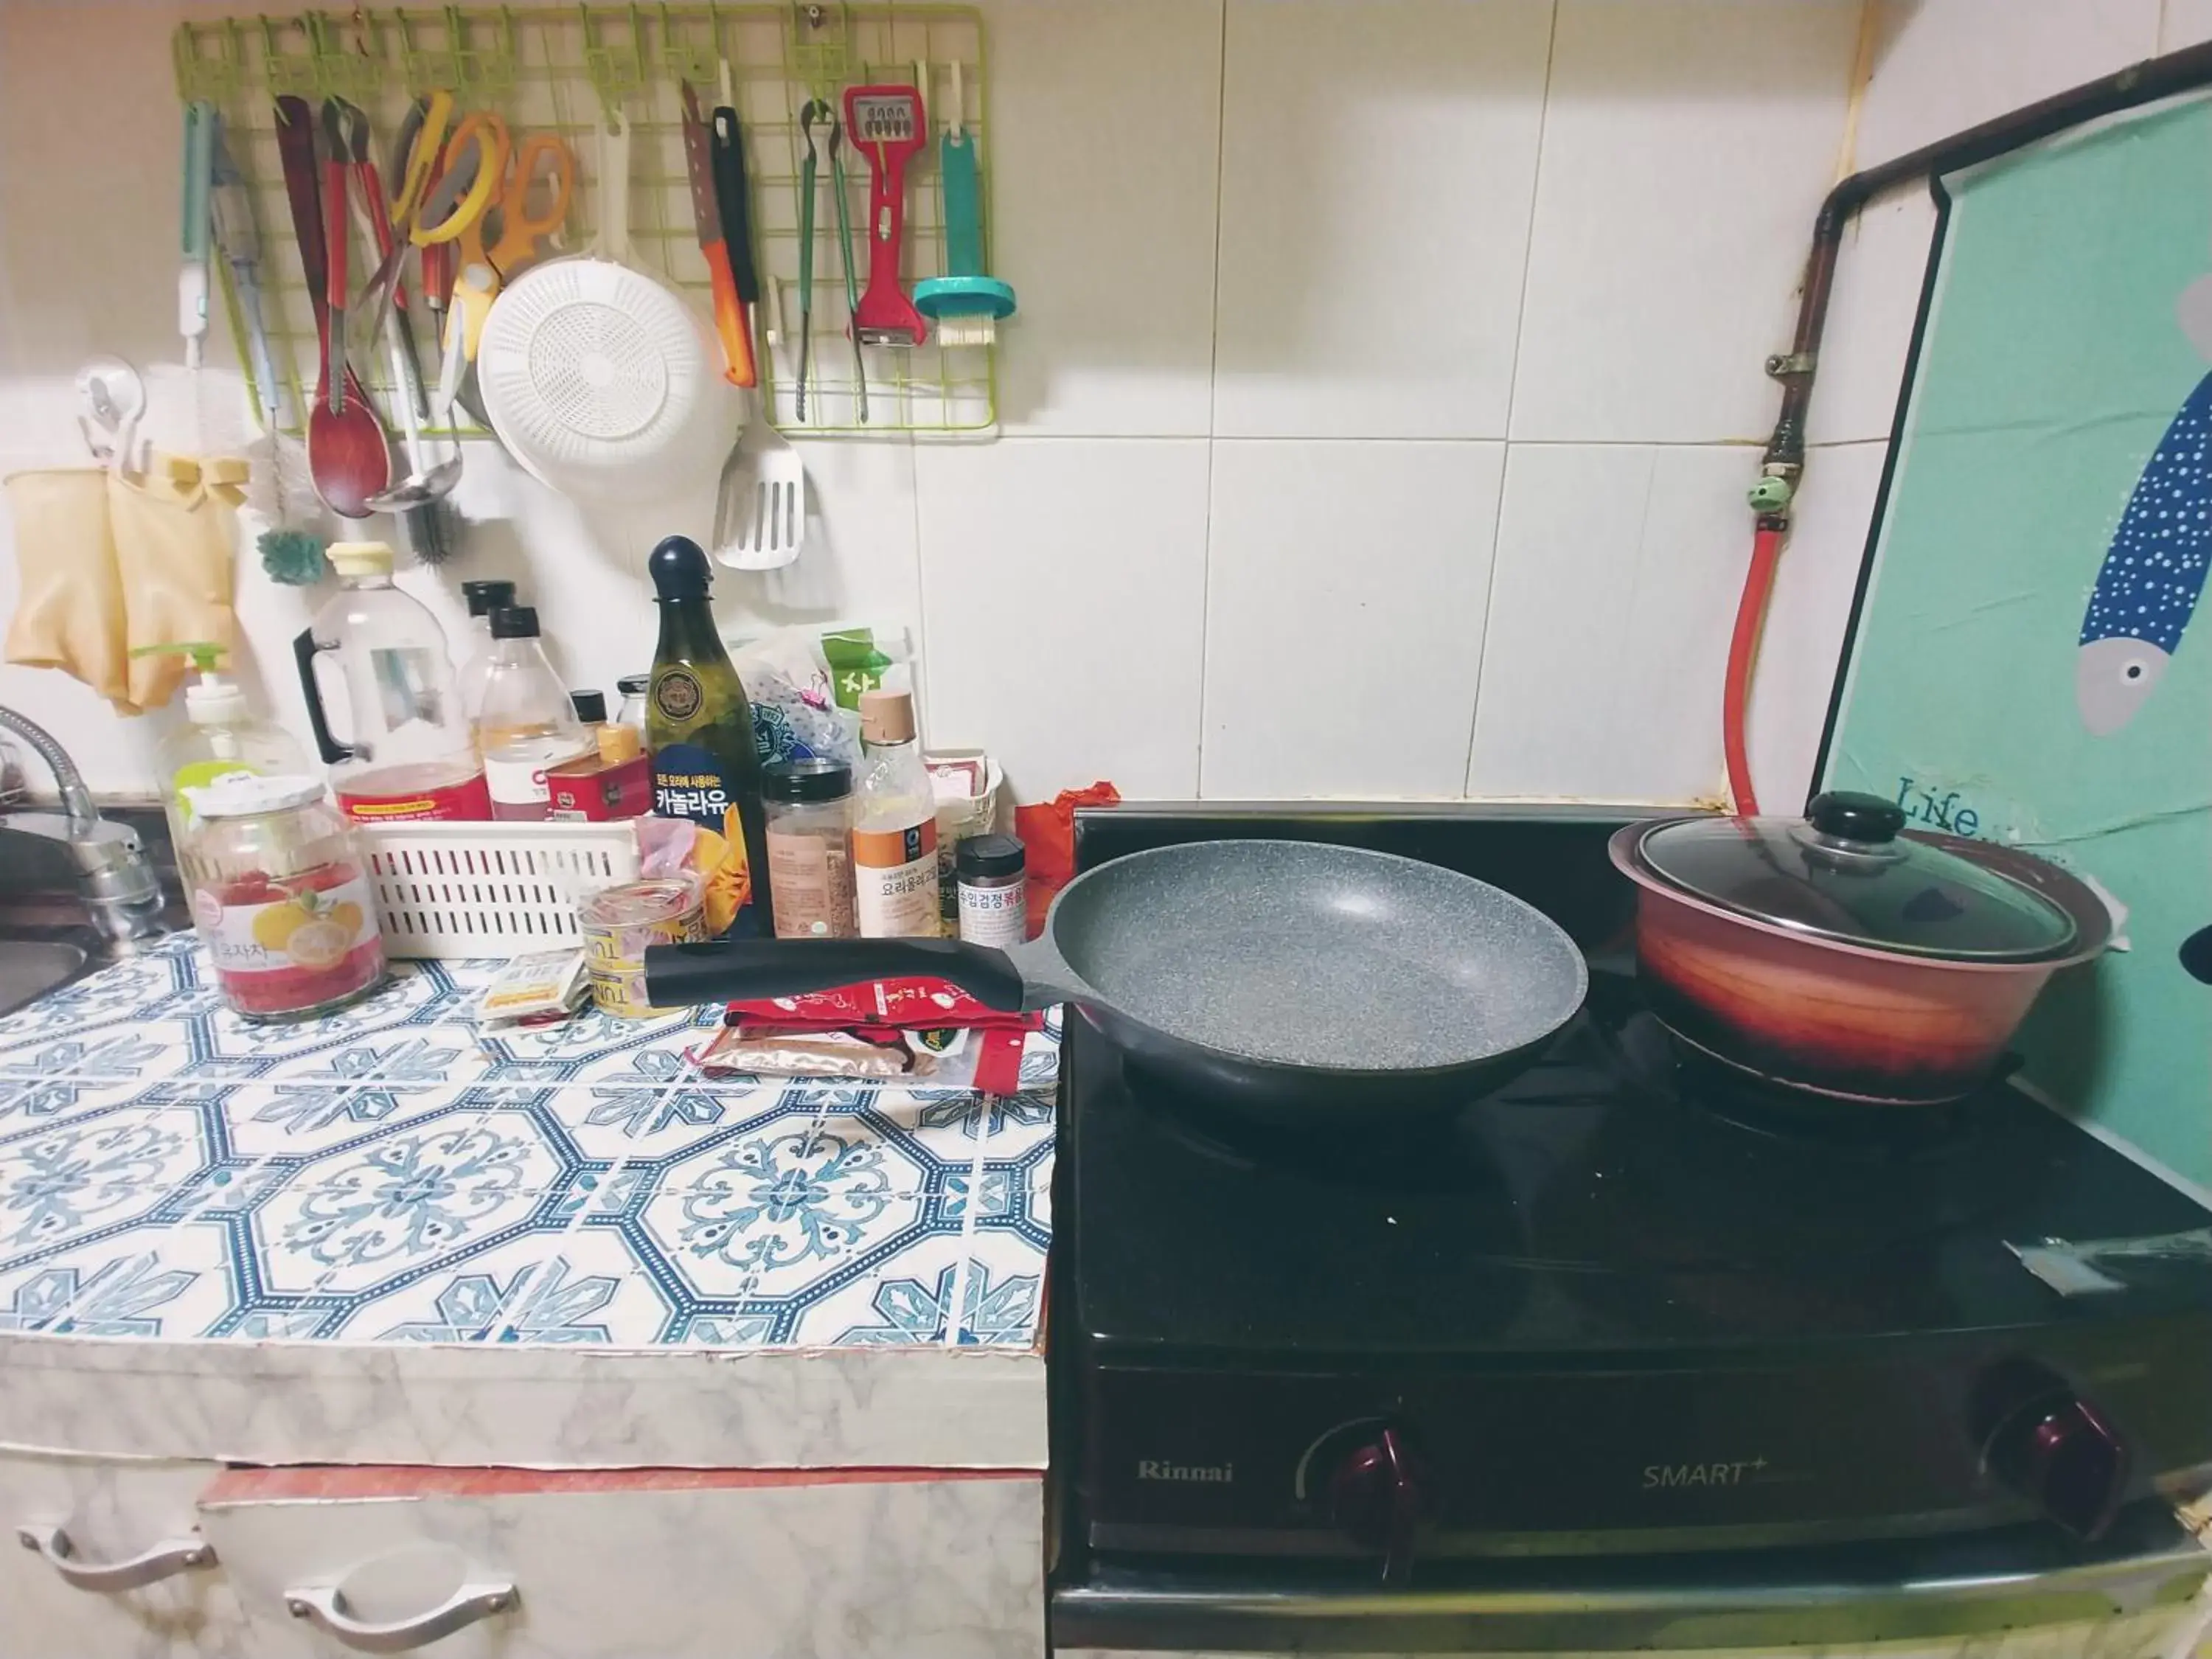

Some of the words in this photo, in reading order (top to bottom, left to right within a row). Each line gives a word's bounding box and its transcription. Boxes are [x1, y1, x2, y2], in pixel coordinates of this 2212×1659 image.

[655, 788, 729, 816] 카놀라유
[1897, 776, 1980, 838] Life
[1138, 1459, 1234, 1483] Rinnai
